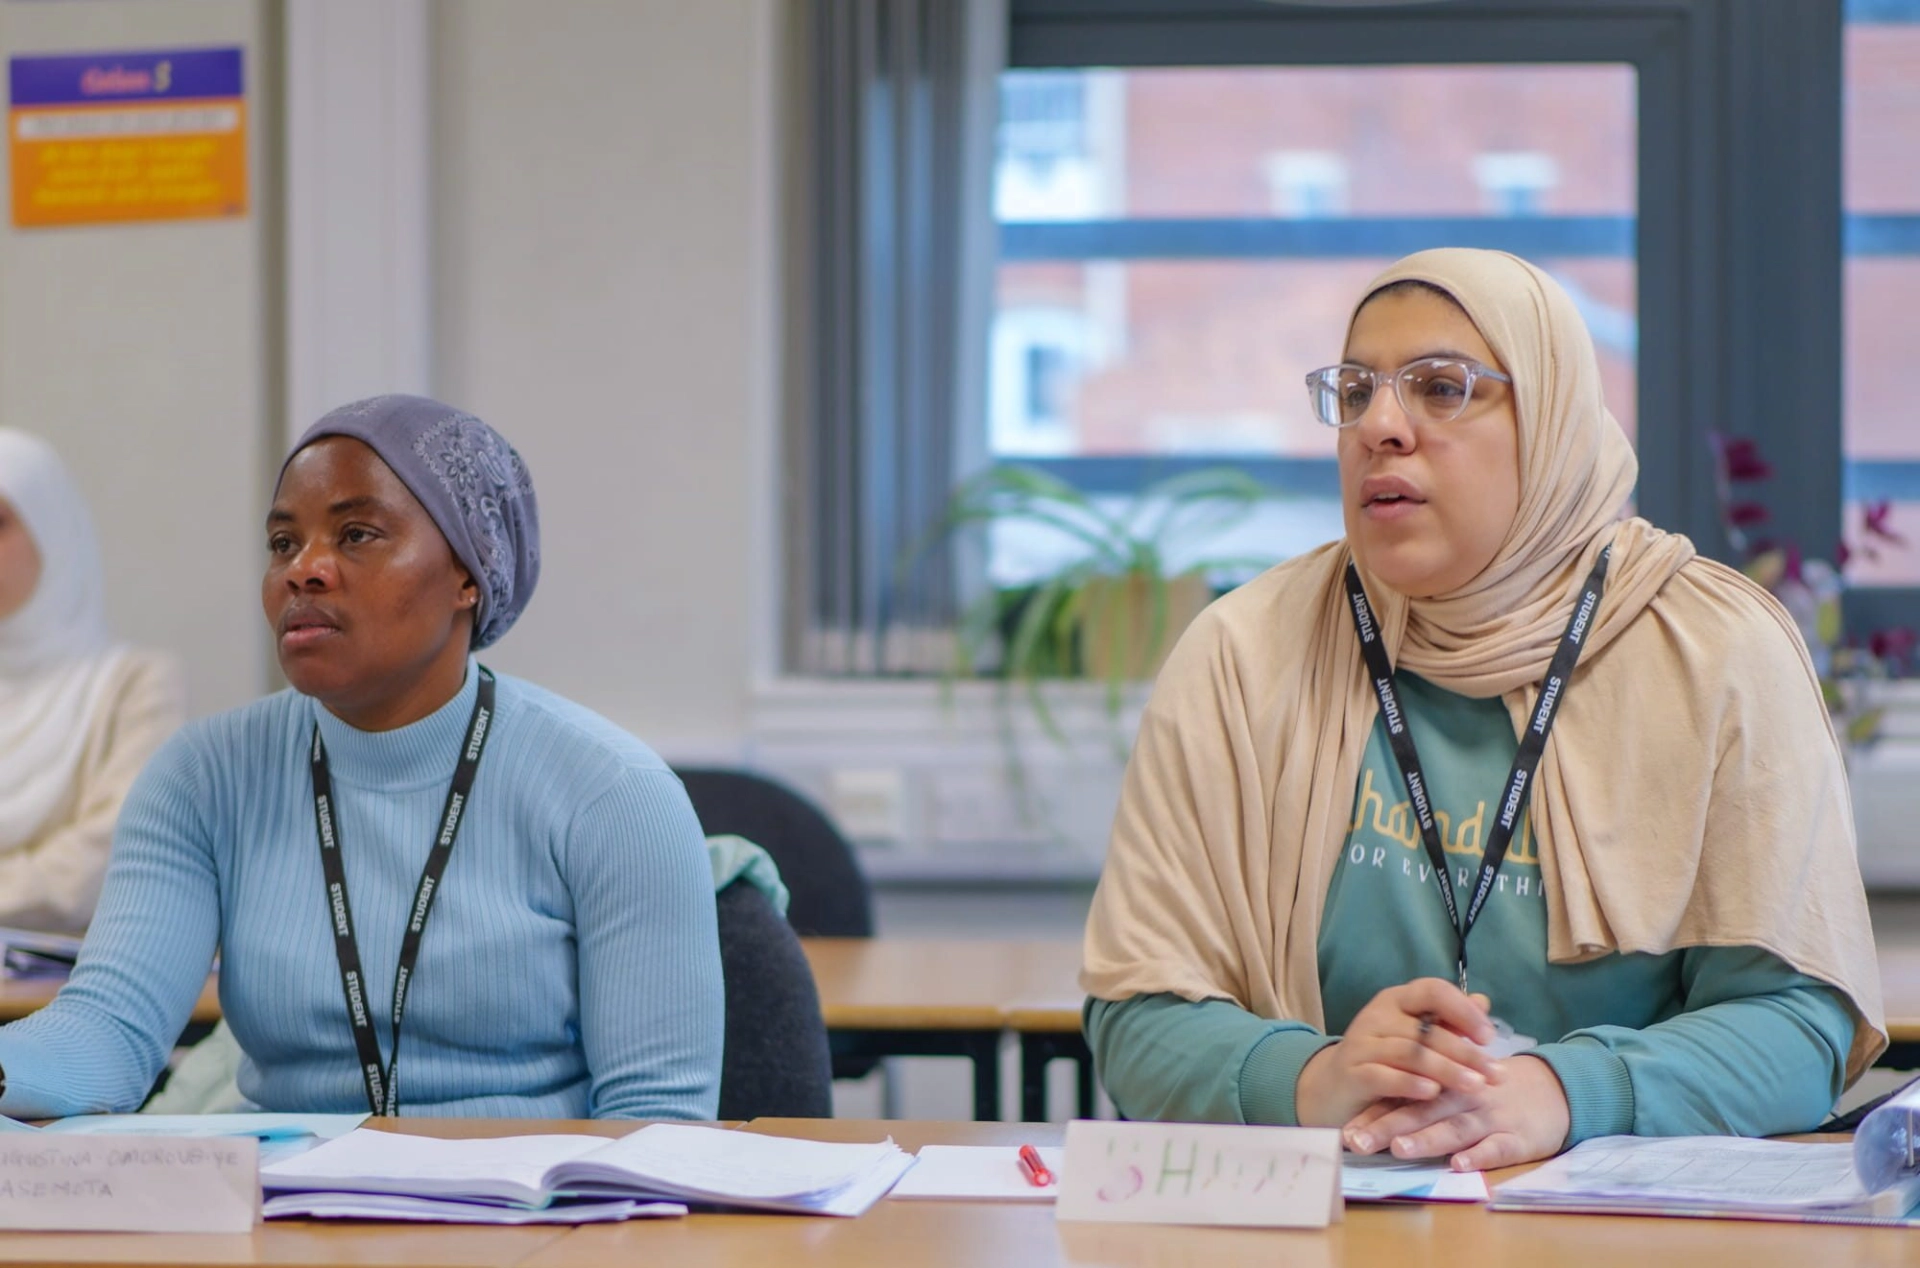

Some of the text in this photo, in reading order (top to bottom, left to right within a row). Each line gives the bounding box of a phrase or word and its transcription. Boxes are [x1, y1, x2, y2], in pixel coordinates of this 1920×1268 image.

[1352, 592, 1375, 643] STUDENT
[1568, 590, 1597, 645] STUDENT
[466, 706, 491, 761] STUDENT
[1376, 677, 1404, 735] STUDENT
[1532, 675, 1562, 735] STUDENT
[317, 794, 335, 849] STUDENT
[440, 792, 465, 846] STUDENT
[1406, 771, 1433, 831] STUDENT
[1499, 769, 1528, 831] STUDENT
[1350, 843, 1386, 869] OR
[330, 883, 349, 937] STUDENT
[411, 875, 435, 932] STUDENT
[1436, 867, 1458, 927] STUDENT
[1467, 864, 1495, 925] STUDENT
[346, 970, 368, 1027] STUDENT
[394, 965, 409, 1024] STUDENT
[366, 1062, 385, 1113] STUDE
